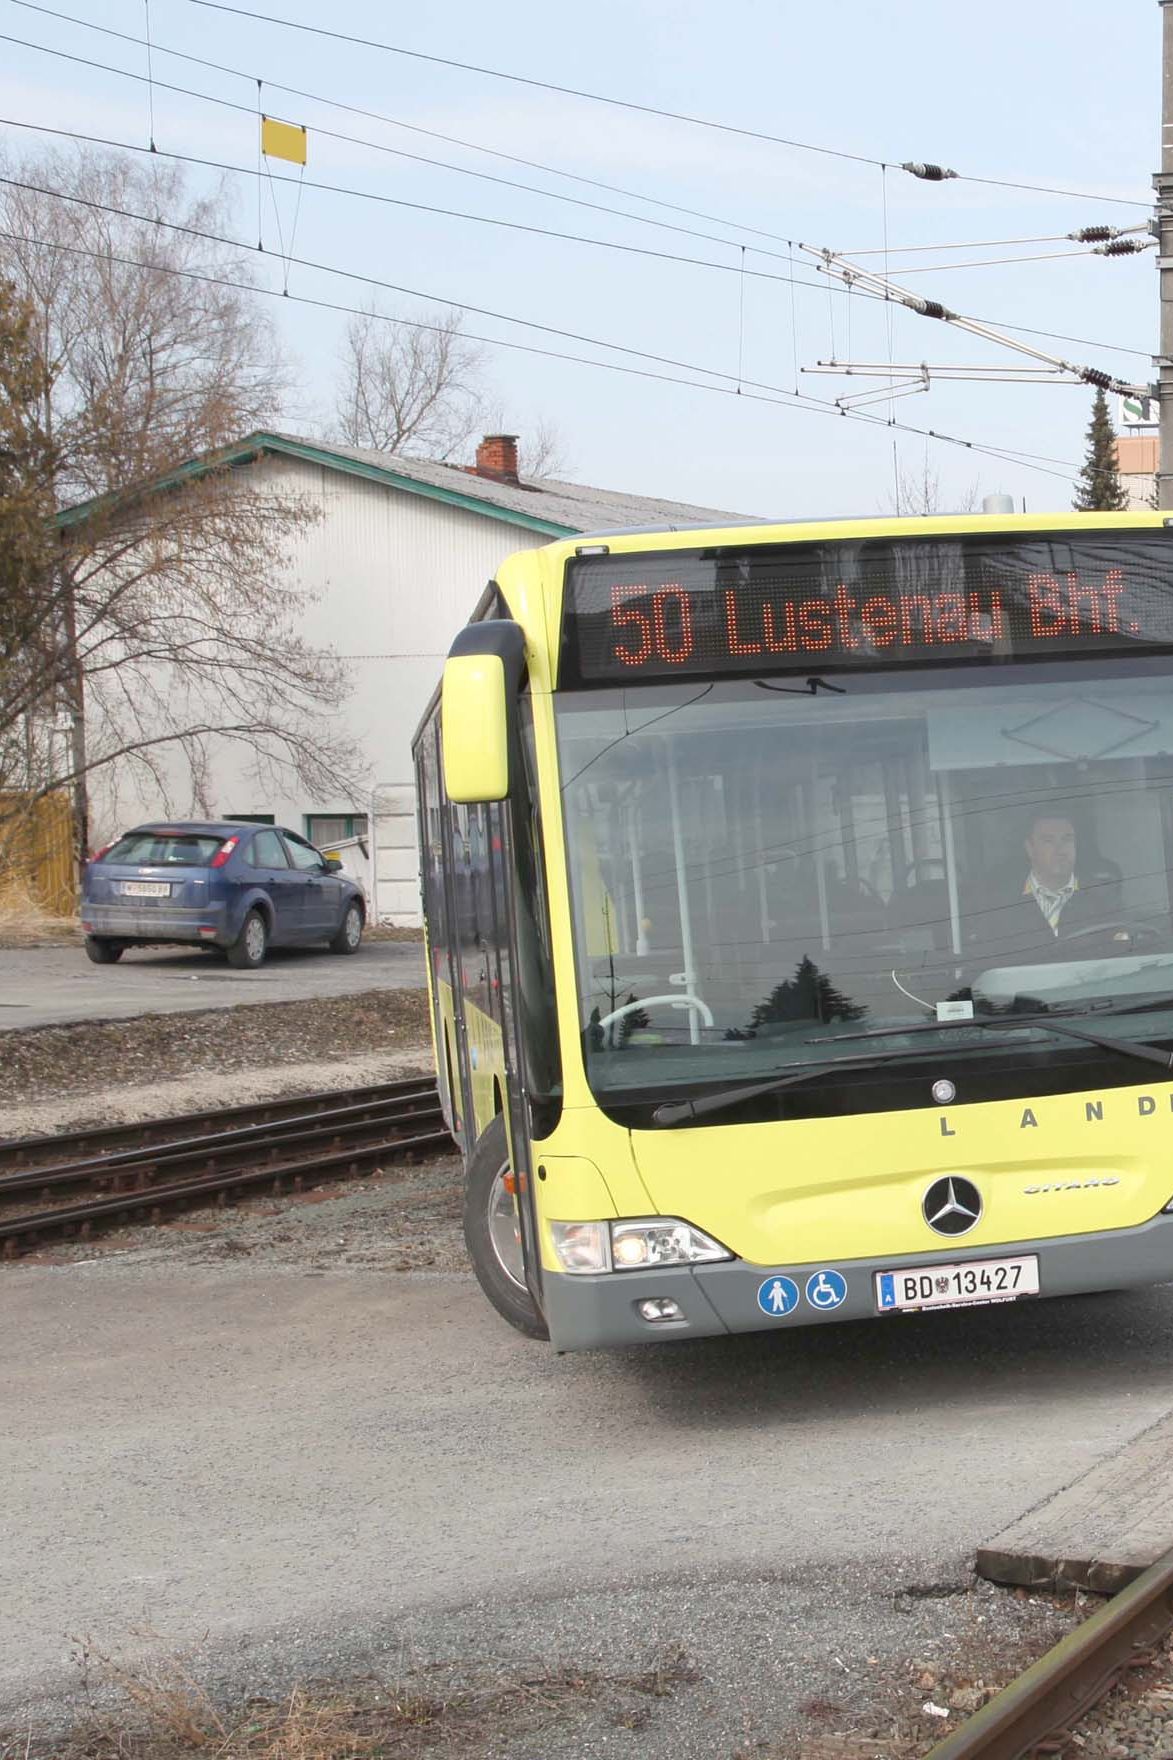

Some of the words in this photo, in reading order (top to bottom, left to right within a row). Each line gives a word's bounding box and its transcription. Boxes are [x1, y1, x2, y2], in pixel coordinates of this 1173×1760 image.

[611, 583, 693, 665] 50
[725, 583, 1002, 654] Lustenau
[1028, 568, 1140, 637] Bhf.
[1023, 1176, 1120, 1195] CITARO
[903, 1276, 933, 1301] BD
[952, 1265, 1022, 1296] 13427
